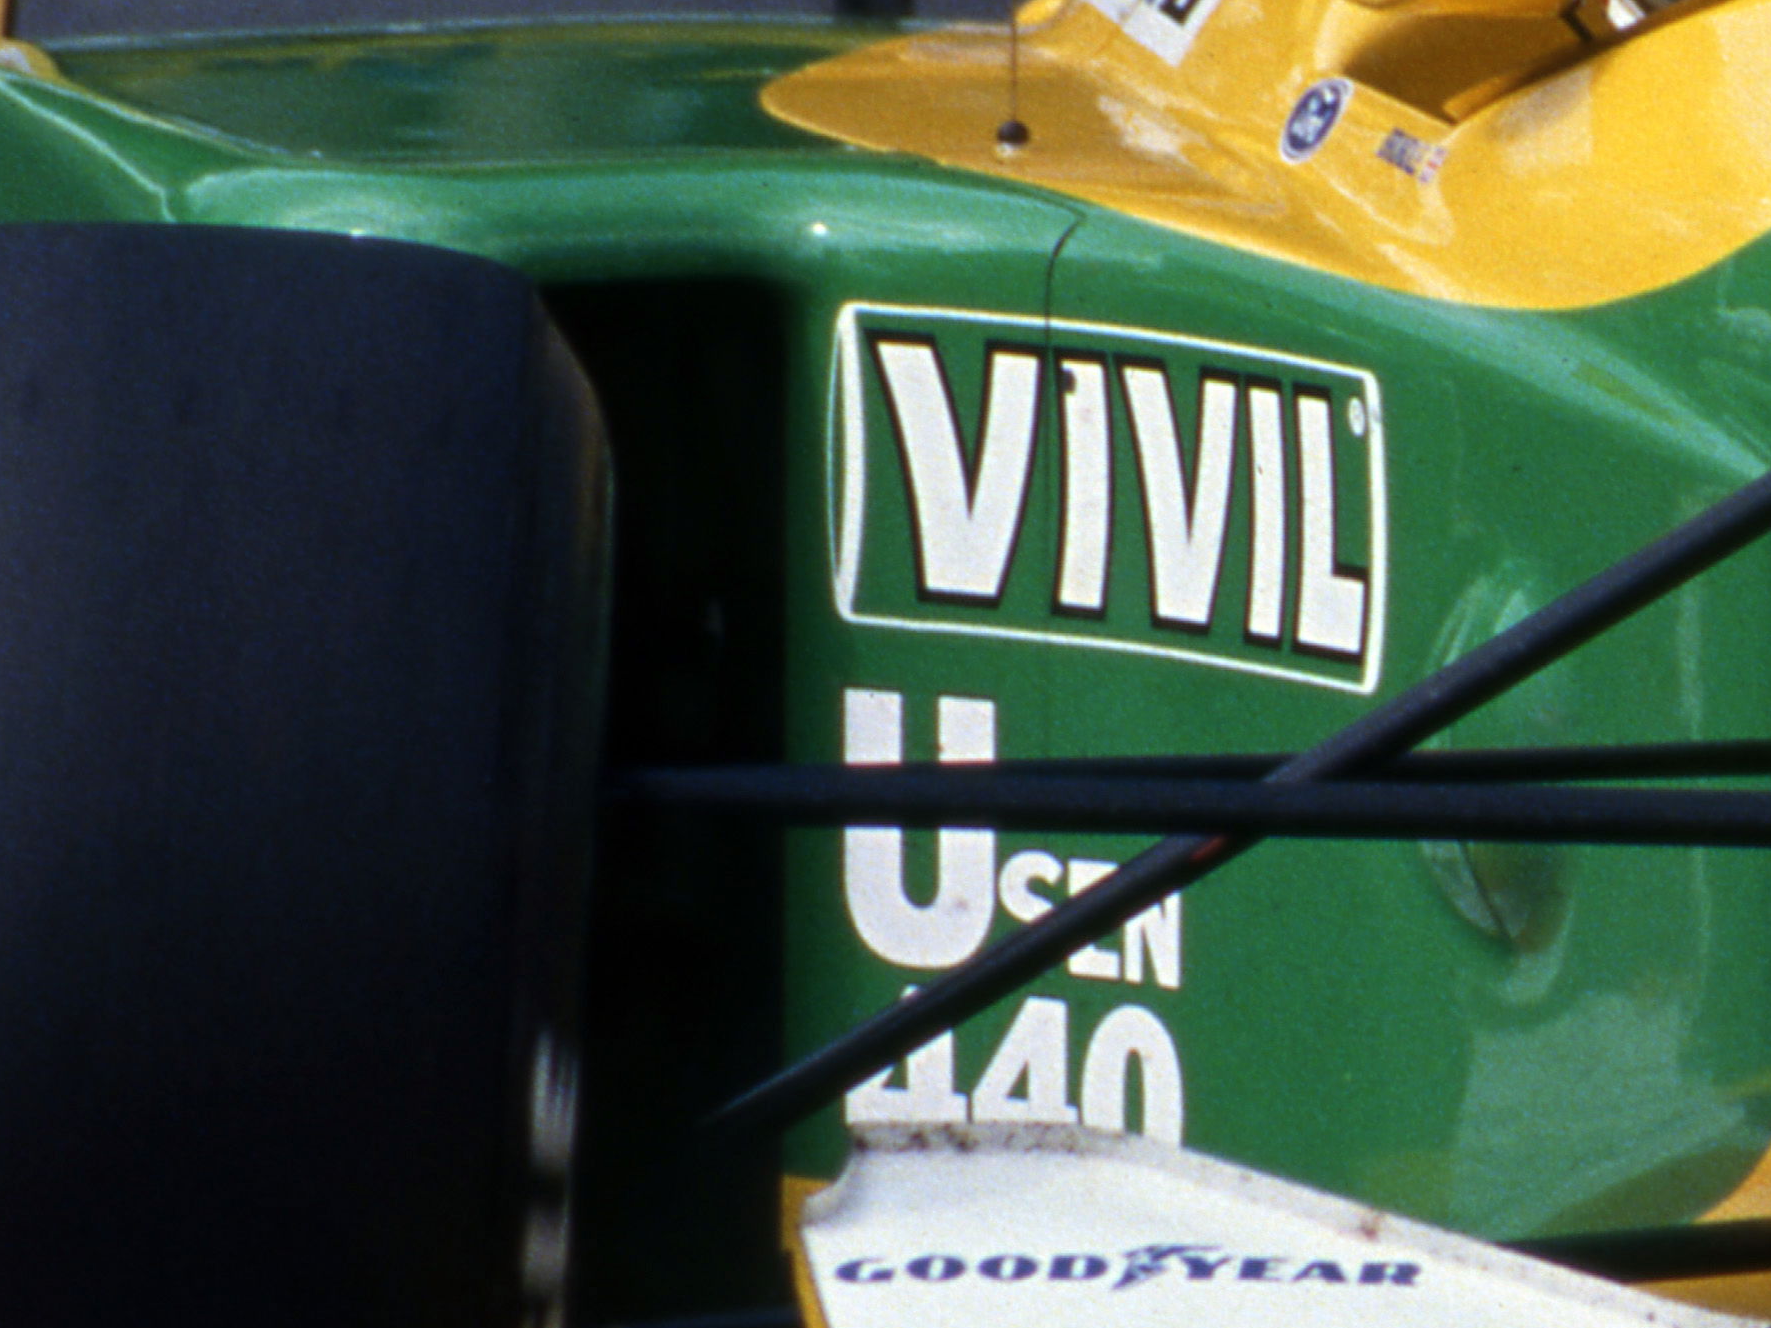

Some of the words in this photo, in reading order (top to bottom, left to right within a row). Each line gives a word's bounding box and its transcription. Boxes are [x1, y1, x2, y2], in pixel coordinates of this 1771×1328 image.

[867, 331, 1369, 667] VIVIL
[844, 984, 1184, 1149] 440
[836, 1243, 1421, 1290] GOODYEAR
